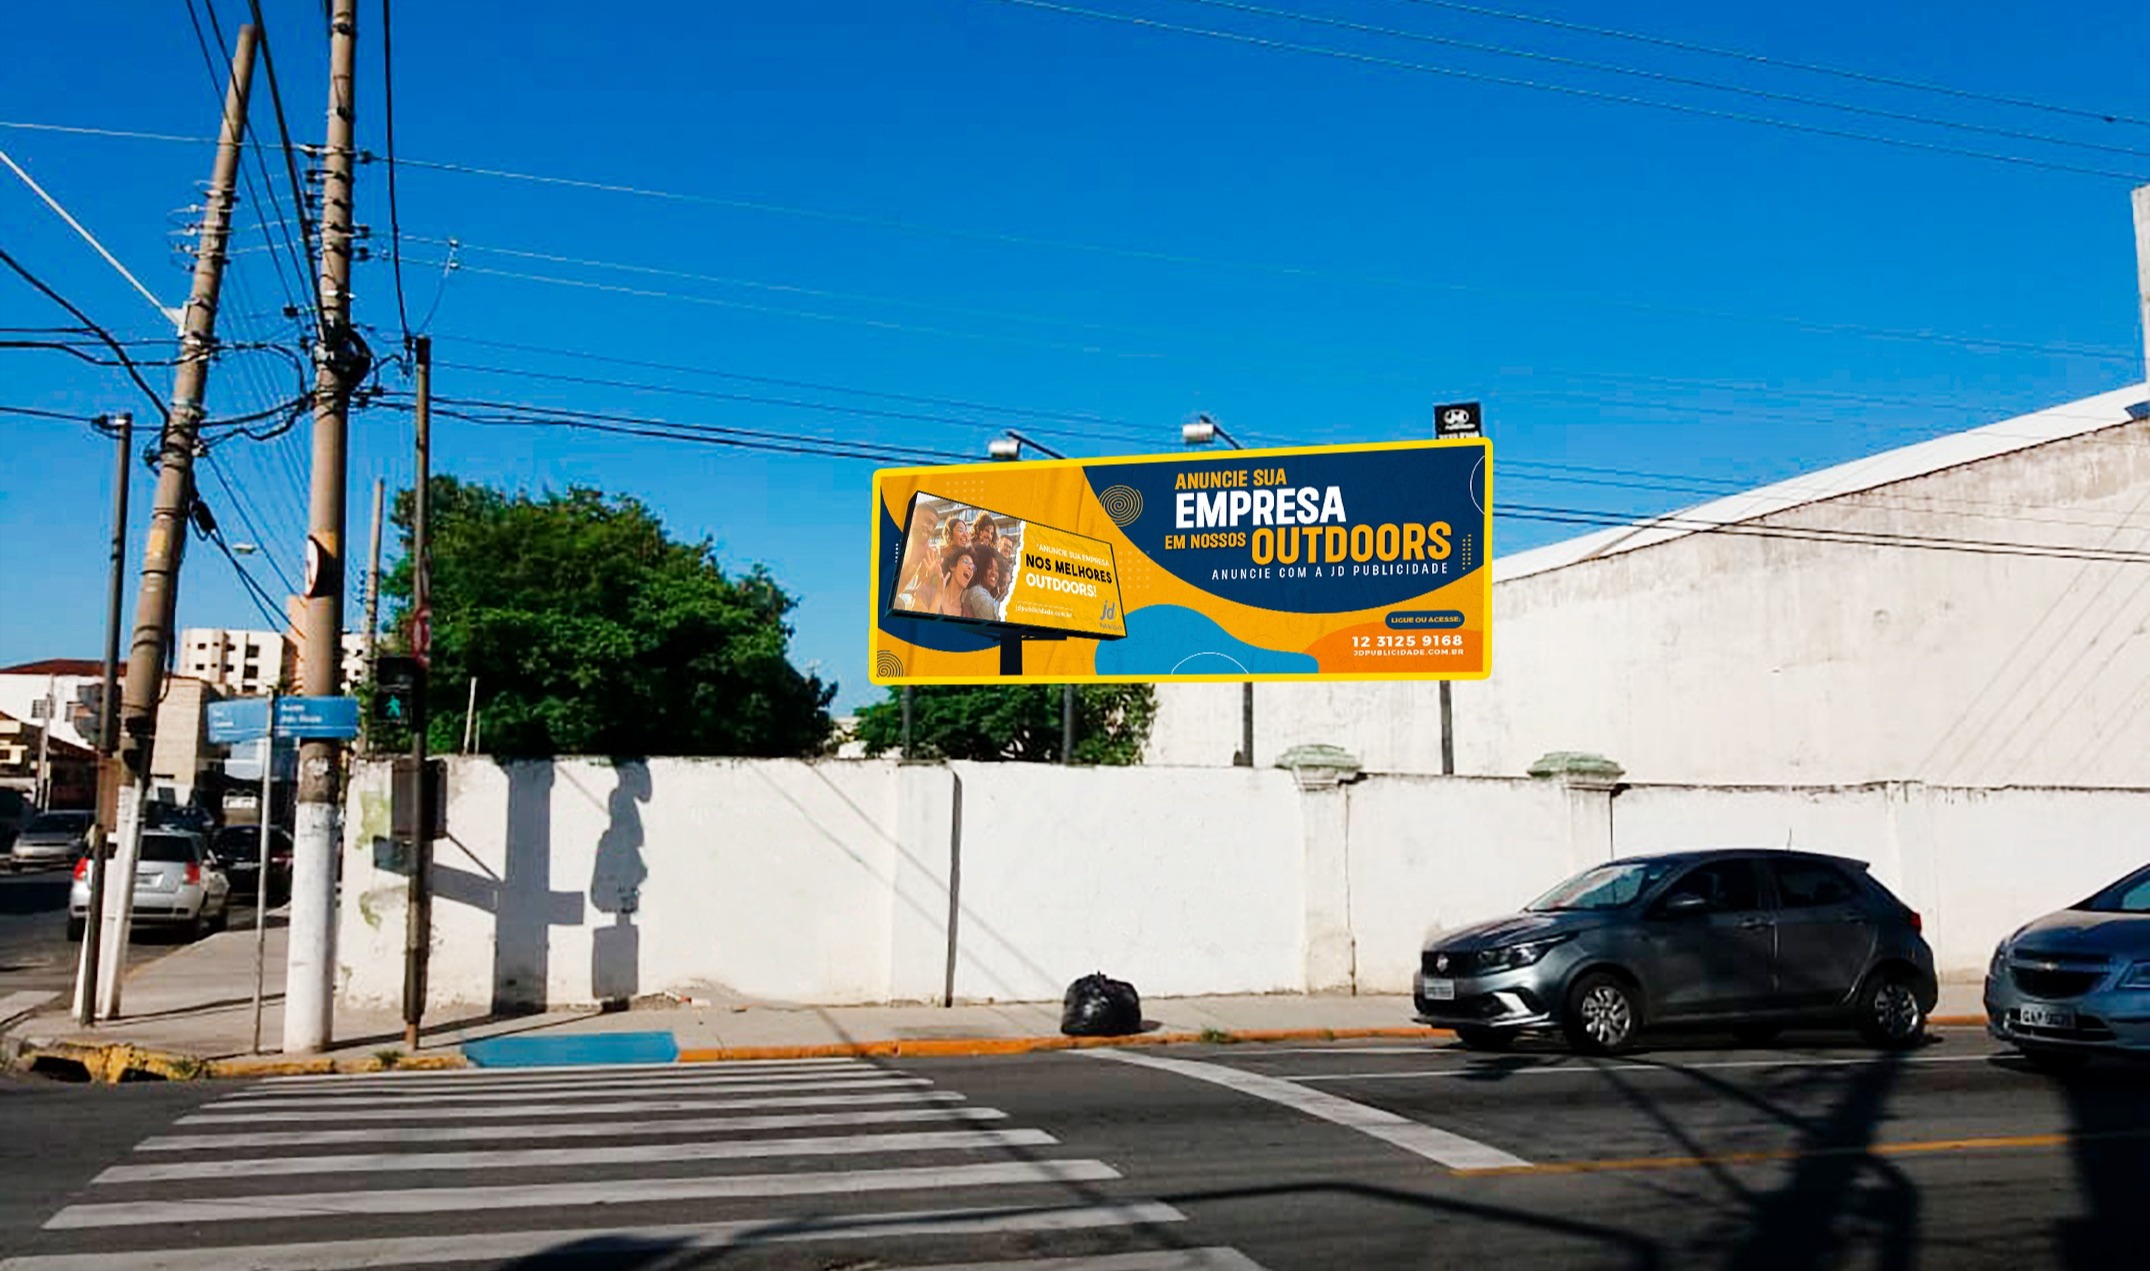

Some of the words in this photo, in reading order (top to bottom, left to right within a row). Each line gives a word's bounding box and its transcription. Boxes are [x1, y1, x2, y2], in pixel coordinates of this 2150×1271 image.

[1175, 470, 1248, 490] ANUNCIE
[1253, 468, 1287, 487] SUA
[1176, 486, 1346, 529] EMPRESA
[1165, 535, 1186, 550] EM
[1190, 532, 1246, 549] NOSSOS
[1251, 521, 1452, 566] OUTDOORS
[1026, 553, 1052, 571] NOS
[1055, 560, 1113, 584] MELHORES
[1211, 568, 1271, 580] ANUNCIE
[1279, 567, 1307, 578] COM
[1315, 567, 1323, 577] A
[1331, 566, 1345, 577] JD
[1353, 562, 1448, 577] PUBLICIDADE
[1026, 572, 1097, 598] OUTDOORS!
[1100, 600, 1116, 621] jd
[1352, 636, 1371, 648] 12
[1376, 635, 1416, 647] 3125
[1422, 635, 1463, 647] 9168
[1353, 648, 1464, 656] JDPUBLICIDADE.COM.BR
